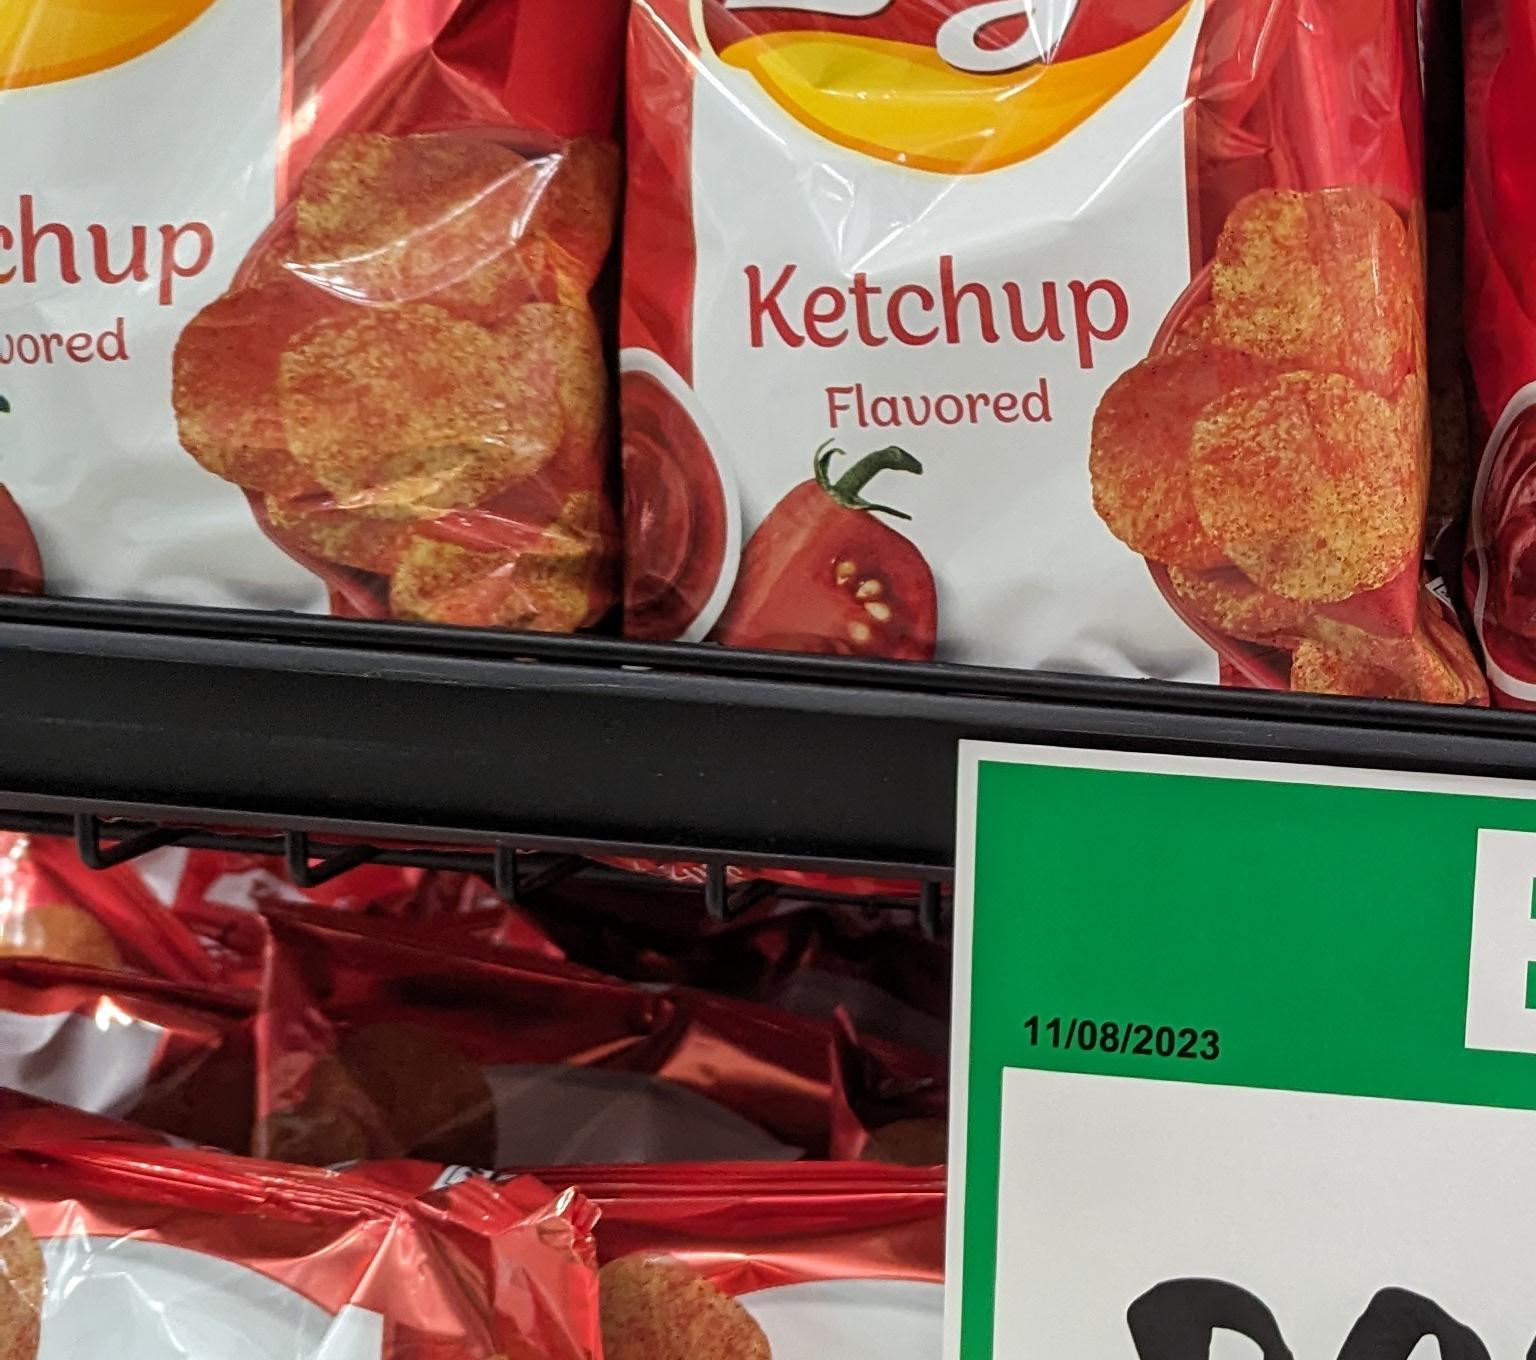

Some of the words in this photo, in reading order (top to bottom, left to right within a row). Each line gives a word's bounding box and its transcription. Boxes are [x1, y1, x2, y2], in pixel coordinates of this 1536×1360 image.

[743, 254, 1130, 370] Ketchup
[824, 377, 1053, 430] Flavored
[1023, 1014, 1221, 1061] 11/08/2023
